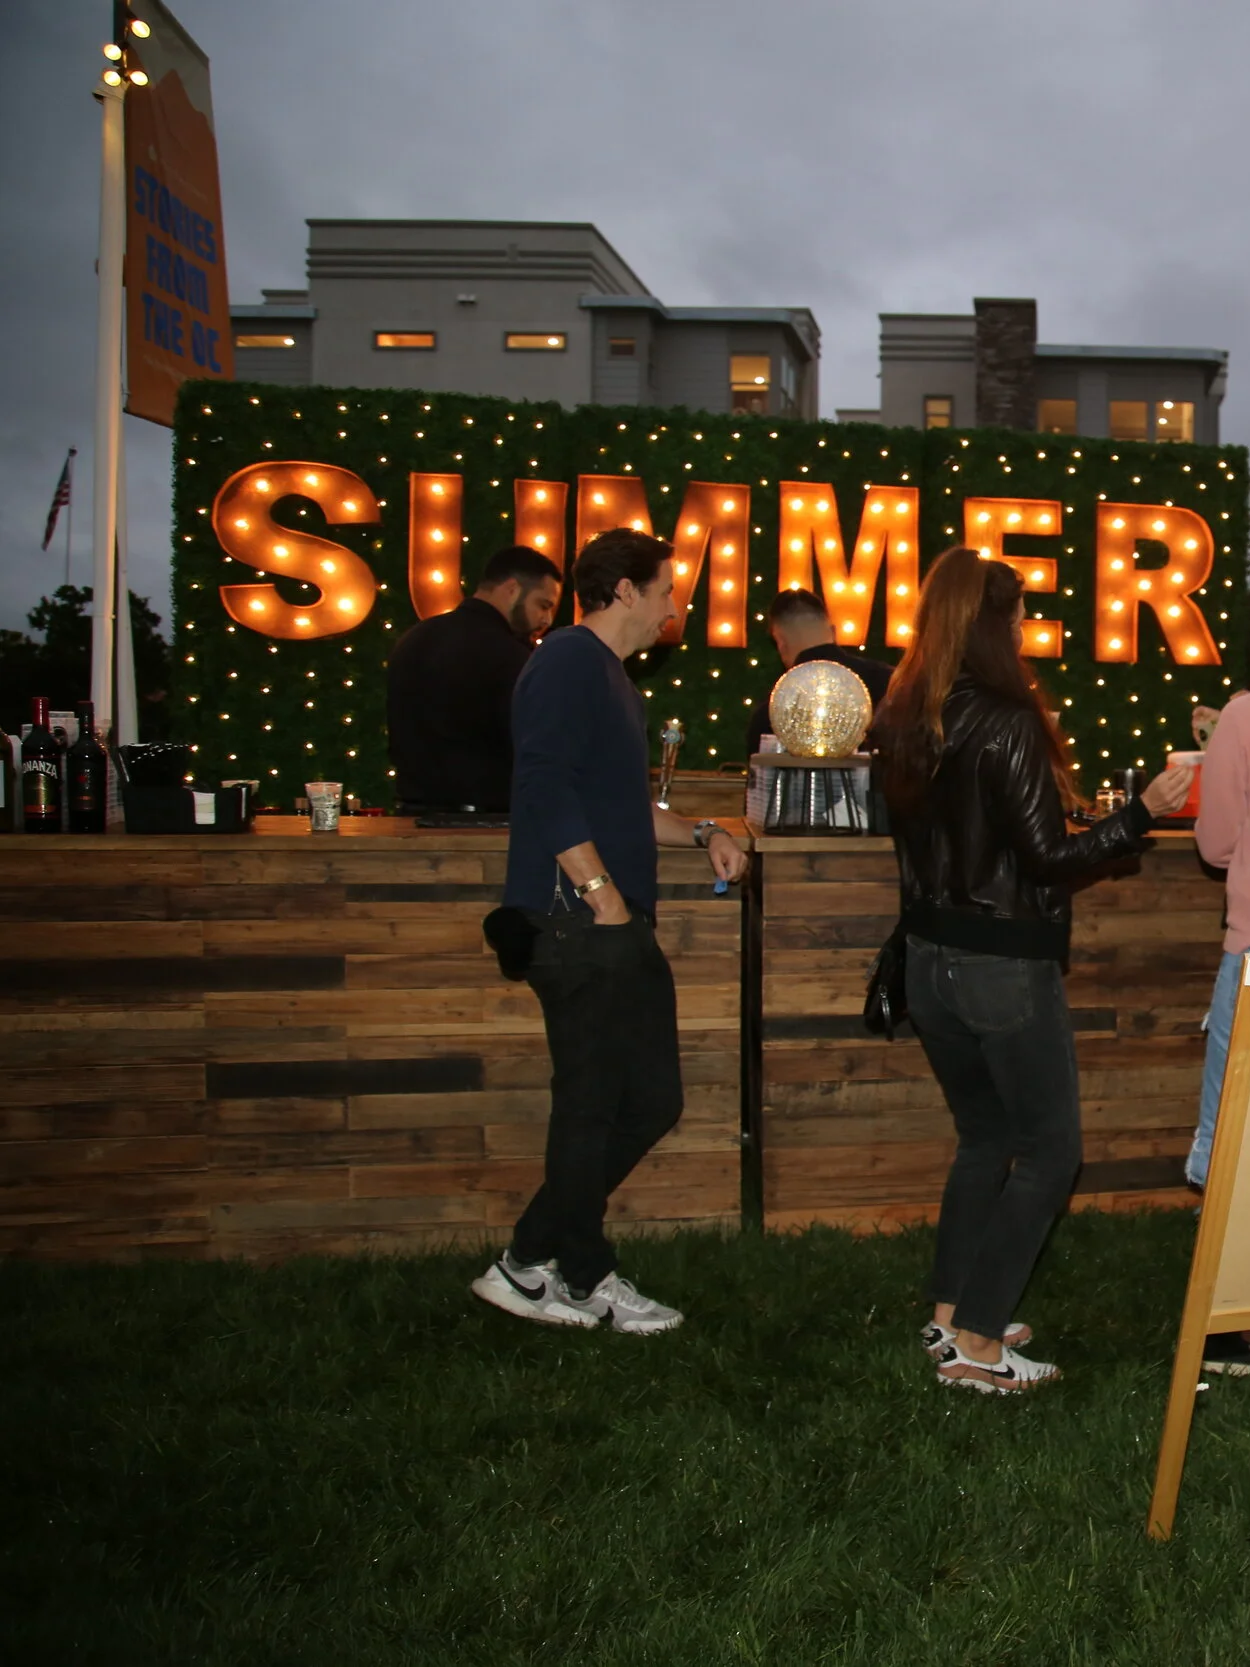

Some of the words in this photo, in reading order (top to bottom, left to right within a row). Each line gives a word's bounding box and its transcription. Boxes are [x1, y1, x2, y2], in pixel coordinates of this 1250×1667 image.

[134, 166, 217, 264] STORIES
[146, 233, 210, 314] FROM
[142, 293, 184, 357] THE
[191, 318, 222, 374] OC
[211, 460, 1222, 666] SUMMER
